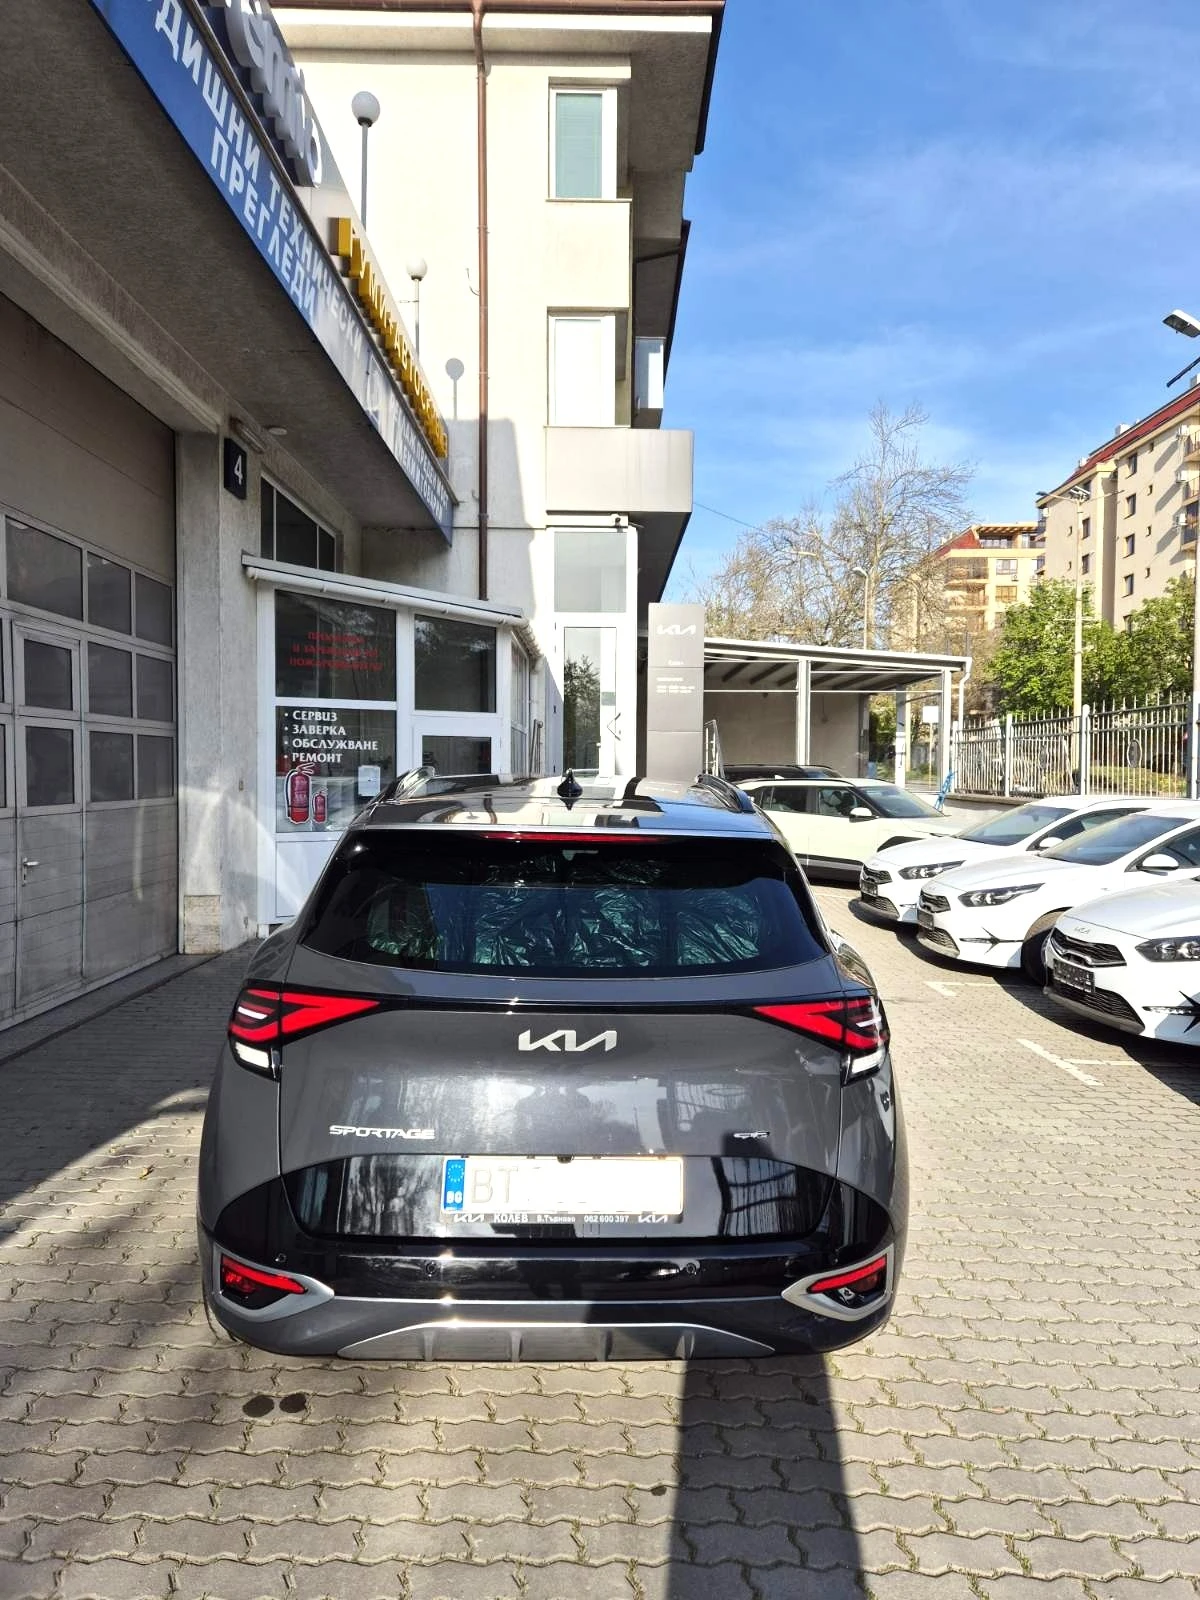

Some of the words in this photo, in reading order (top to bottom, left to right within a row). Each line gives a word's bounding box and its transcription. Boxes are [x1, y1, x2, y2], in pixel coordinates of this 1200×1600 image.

[153, 0, 261, 184] ДИШНИ
[269, 171, 363, 358] ТЕХНИЧЕСКИ
[210, 127, 316, 327] ПРЕГЛЕДИ
[234, 455, 243, 485] 4
[656, 624, 697, 635] KIA
[292, 710, 338, 722] СЕРВИЗ
[292, 724, 346, 736] ЗАВЕРКА
[292, 738, 379, 751] ОБСЛУЖВАНЕ
[292, 752, 343, 763] РЕМОНТ
[518, 1029, 617, 1052] KIA
[329, 1125, 436, 1140] SPORTAGE
[454, 1213, 485, 1223] KIA
[494, 1213, 529, 1223] КОЛЕВ
[638, 1214, 668, 1223] KIA
